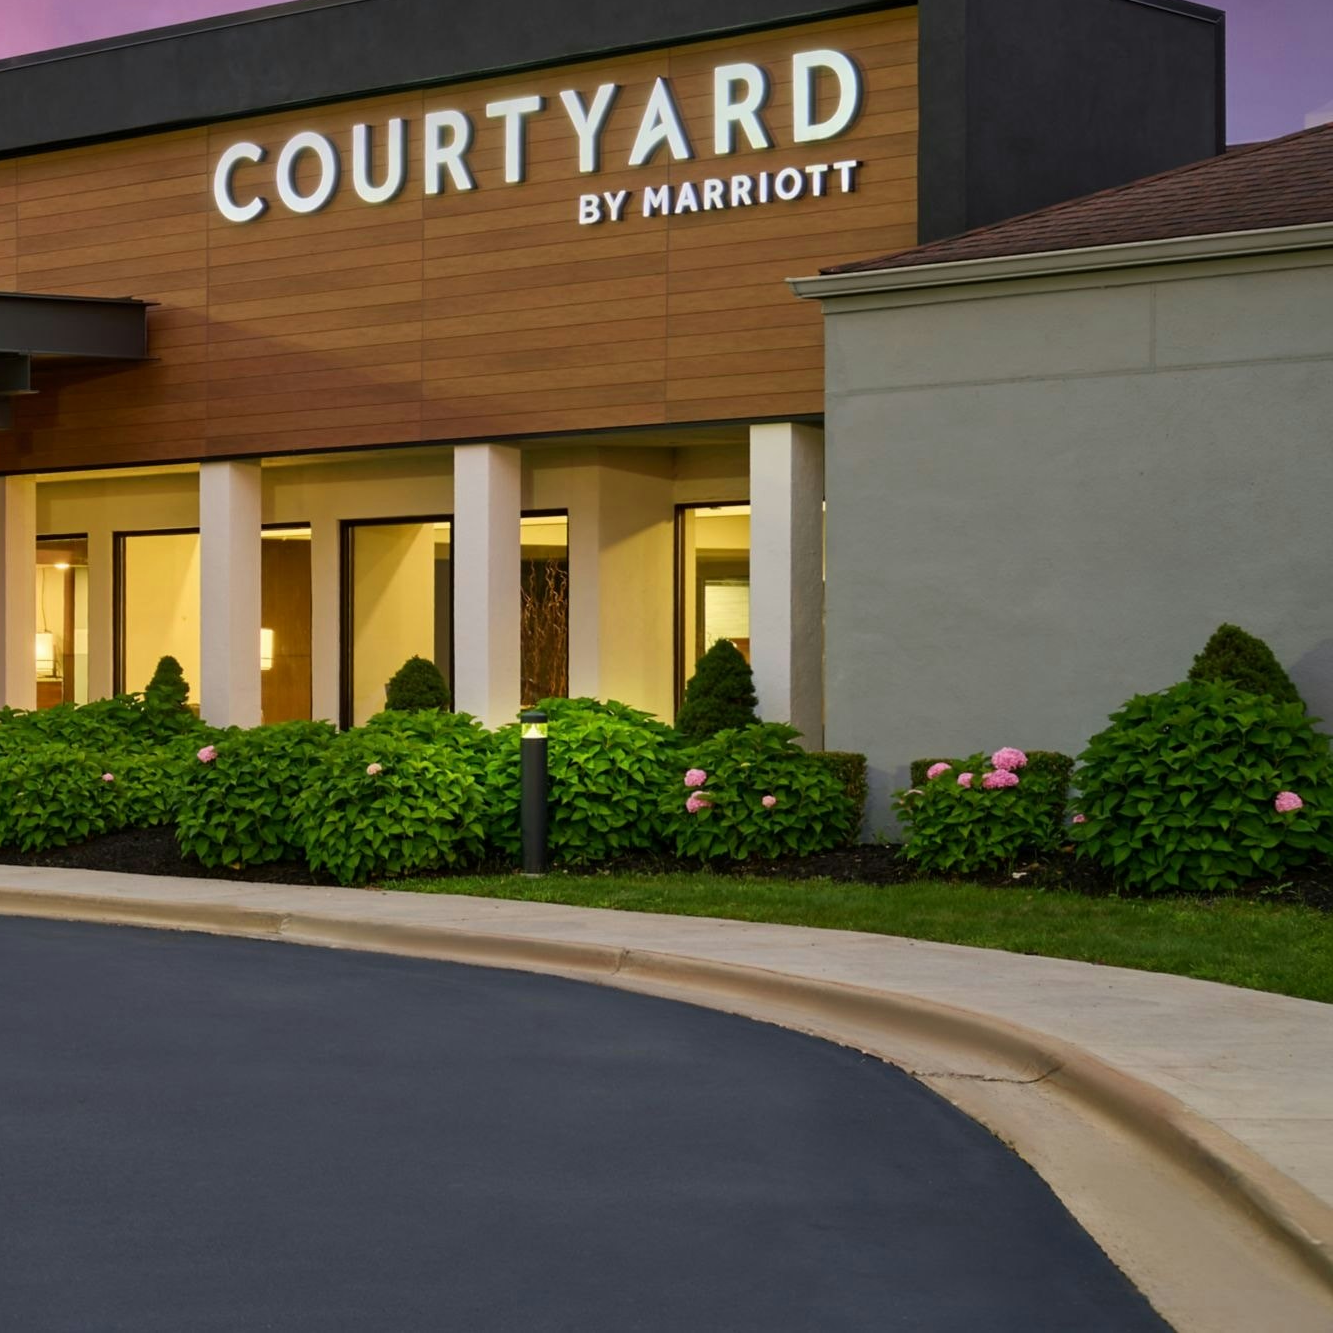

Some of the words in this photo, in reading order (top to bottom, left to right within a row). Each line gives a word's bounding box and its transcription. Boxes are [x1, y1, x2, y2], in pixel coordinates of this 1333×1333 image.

[211, 48, 861, 223] COURTYARD
[577, 190, 629, 226] BY
[641, 159, 860, 218] MARRIOTT
